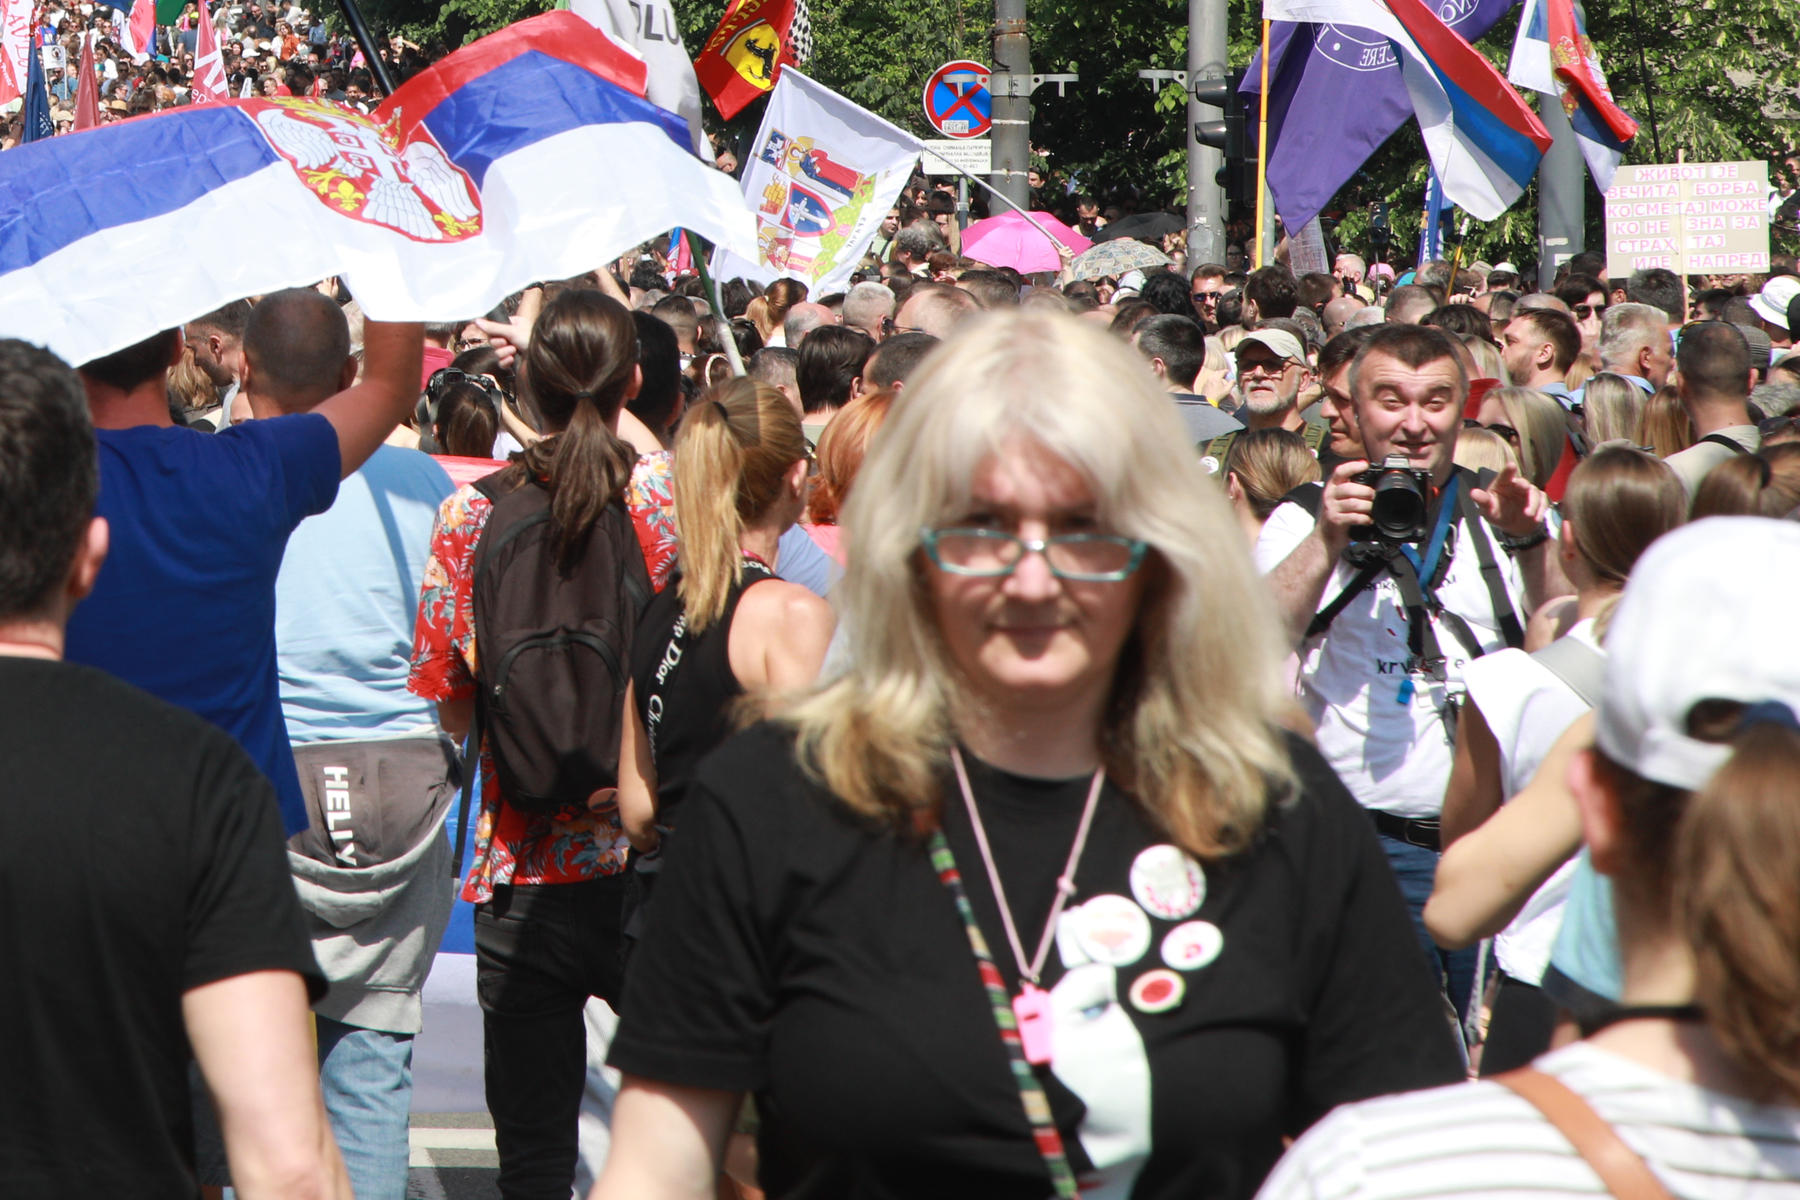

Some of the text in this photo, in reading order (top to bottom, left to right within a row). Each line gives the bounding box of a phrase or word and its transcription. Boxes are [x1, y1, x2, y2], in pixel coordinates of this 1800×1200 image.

[1639, 165, 1737, 181] ЖИВОТ ЈЕ
[1608, 181, 1763, 198] ВЕЧИТА БОРБА.
[1634, 202, 1671, 215] СМЕ
[1675, 201, 1706, 214] ТАЈ
[1710, 198, 1767, 211] МОЖЕ
[1615, 217, 1759, 234] КО НЕ ЗНА ЗА
[1693, 235, 1725, 248] ТАЈ
[1634, 253, 1769, 269] ИДЕ НАПРЕД!
[655, 639, 683, 686] Dior
